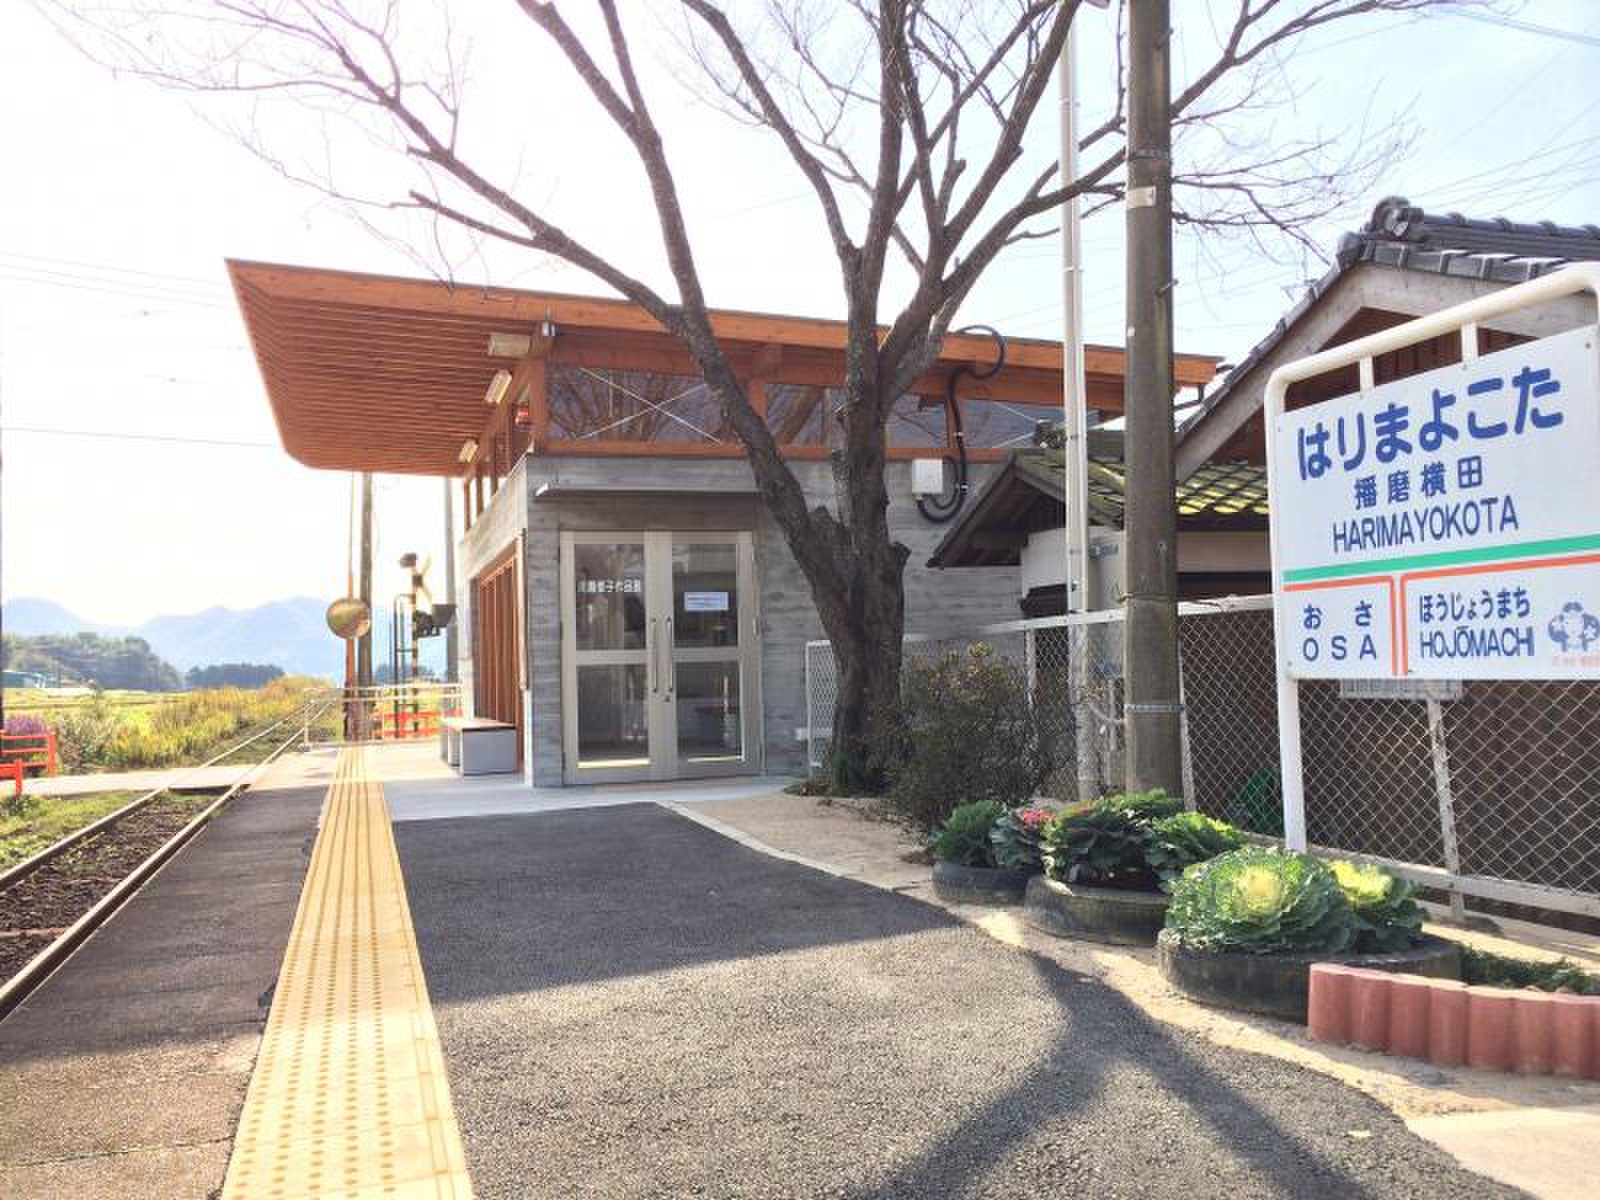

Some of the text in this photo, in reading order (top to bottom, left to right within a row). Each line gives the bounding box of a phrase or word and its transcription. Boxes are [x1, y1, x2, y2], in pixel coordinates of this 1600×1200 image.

[1298, 366, 1564, 481] はりまよこた
[1354, 456, 1484, 510] 播磨横田
[1333, 494, 1520, 553] HARIMAYOKOTA
[1419, 587, 1530, 623] ほうじょうまち
[1303, 634, 1377, 662] OSA
